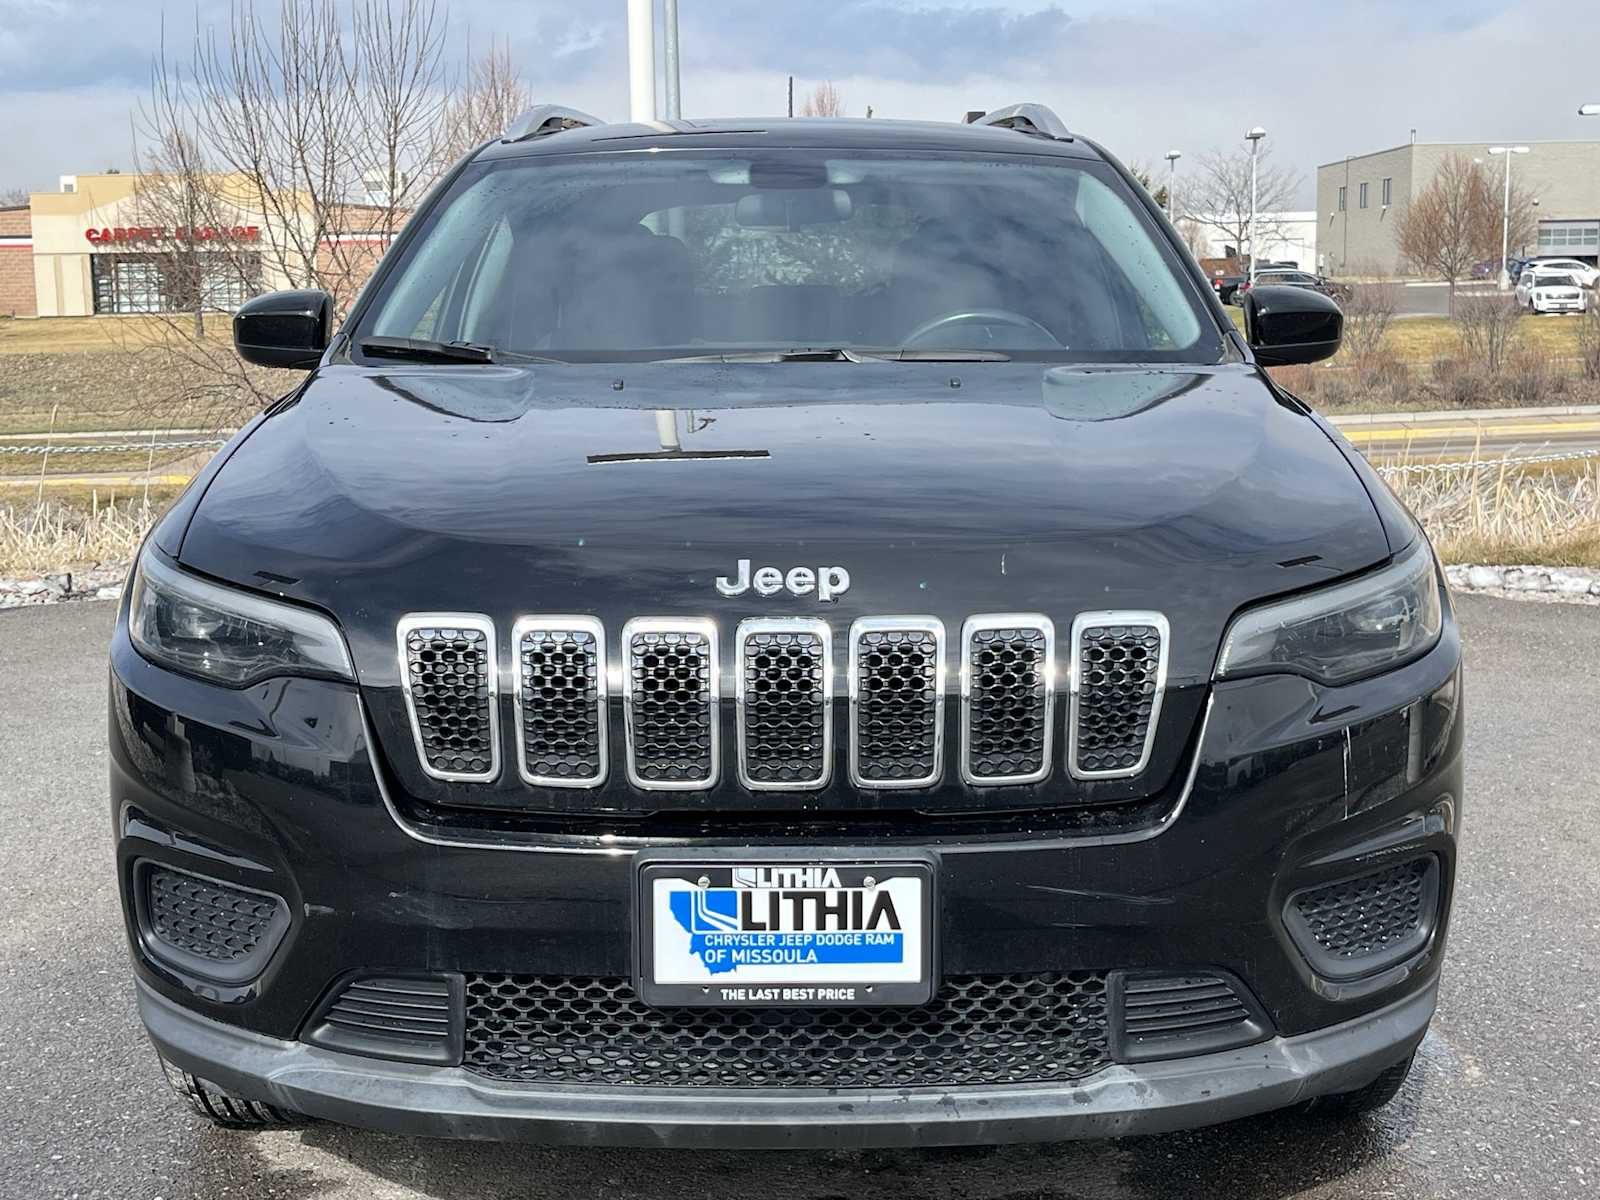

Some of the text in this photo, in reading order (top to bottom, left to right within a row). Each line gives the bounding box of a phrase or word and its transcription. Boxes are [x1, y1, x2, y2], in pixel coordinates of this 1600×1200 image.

[716, 559, 850, 600] Jeep
[757, 867, 842, 888] LITHIA
[741, 890, 902, 931] LITHIA
[705, 933, 895, 947] CHRYSLER JEEP DODGE RAM
[704, 949, 818, 963] OF MISSOULA
[720, 988, 855, 1000] THE LAST BEST PRICE
